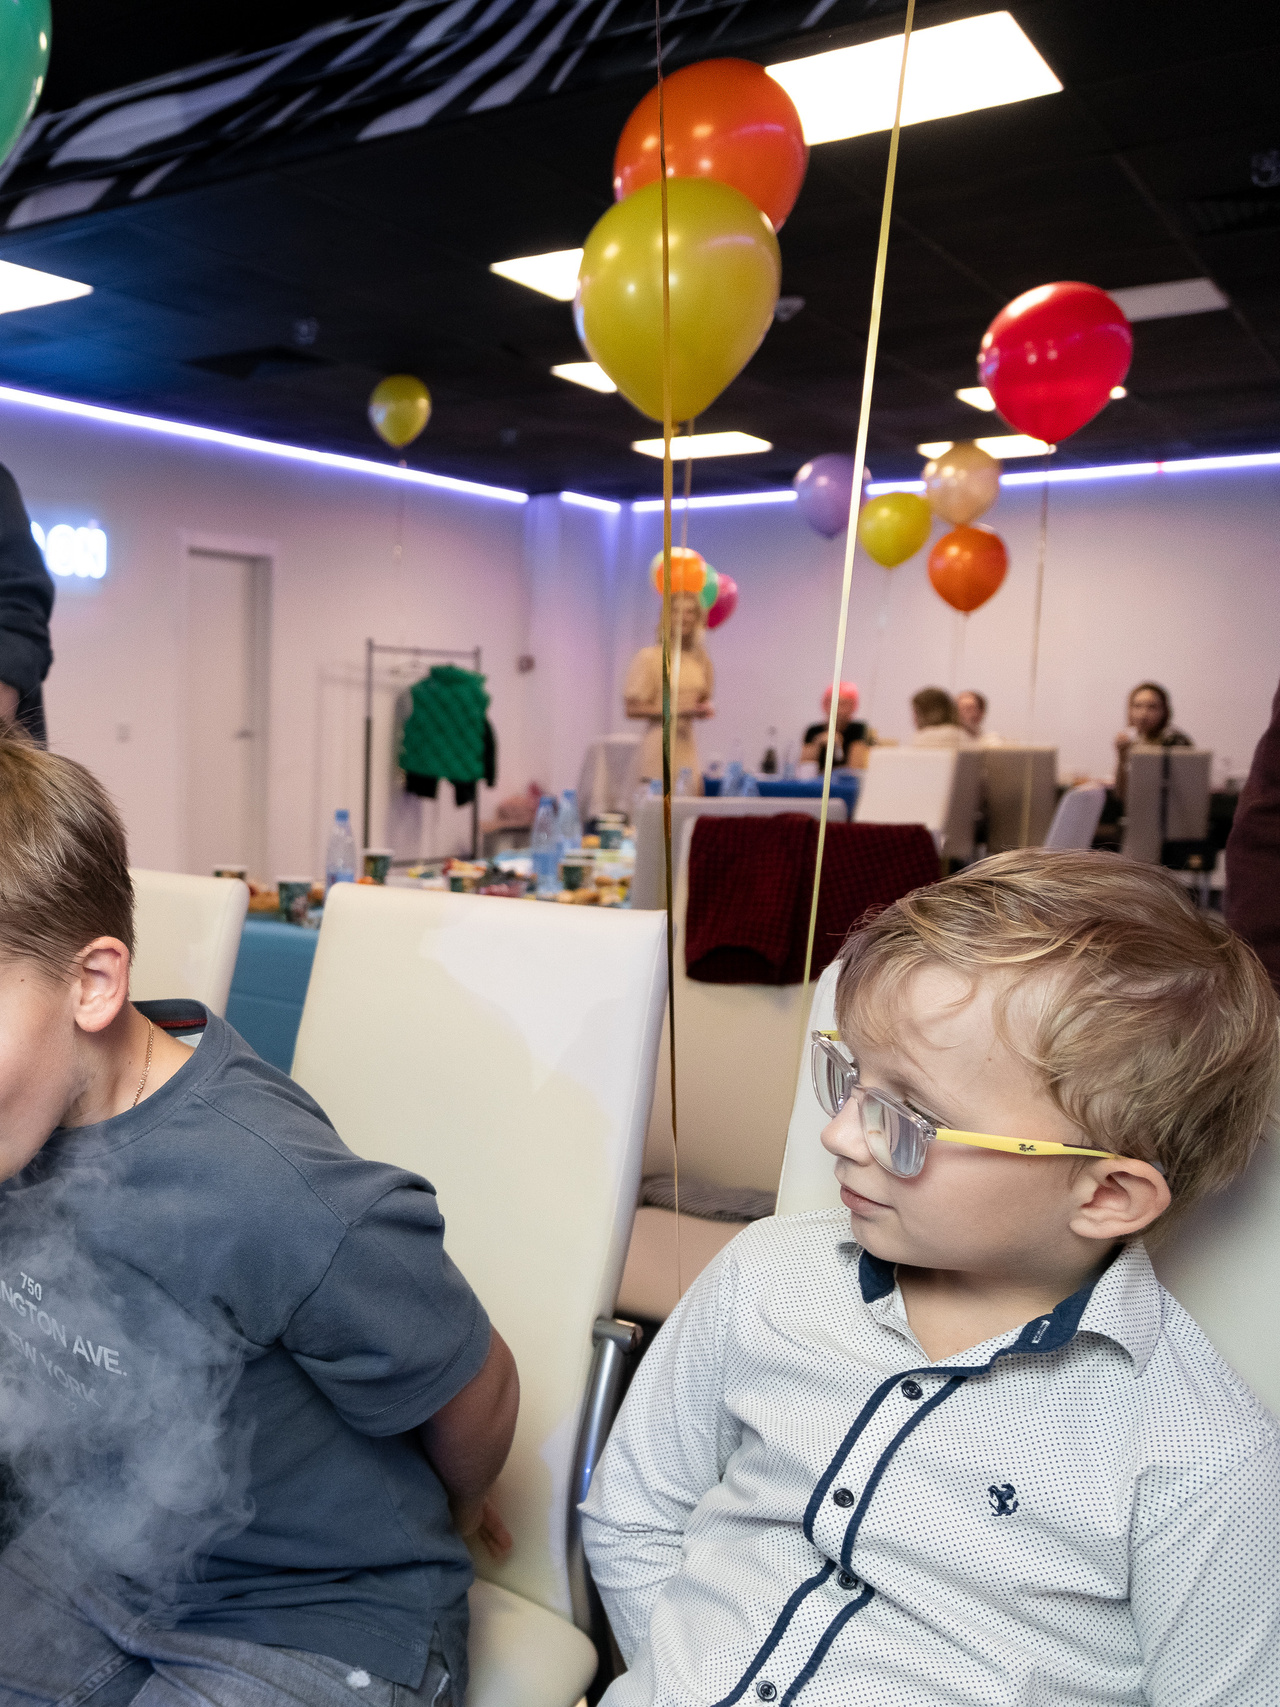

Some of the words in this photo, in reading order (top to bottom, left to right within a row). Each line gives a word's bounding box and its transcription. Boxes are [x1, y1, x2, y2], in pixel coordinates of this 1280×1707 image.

[19, 1271, 43, 1302] 750
[72, 1334, 128, 1376] AVE.
[40, 1352, 103, 1408] YORK
